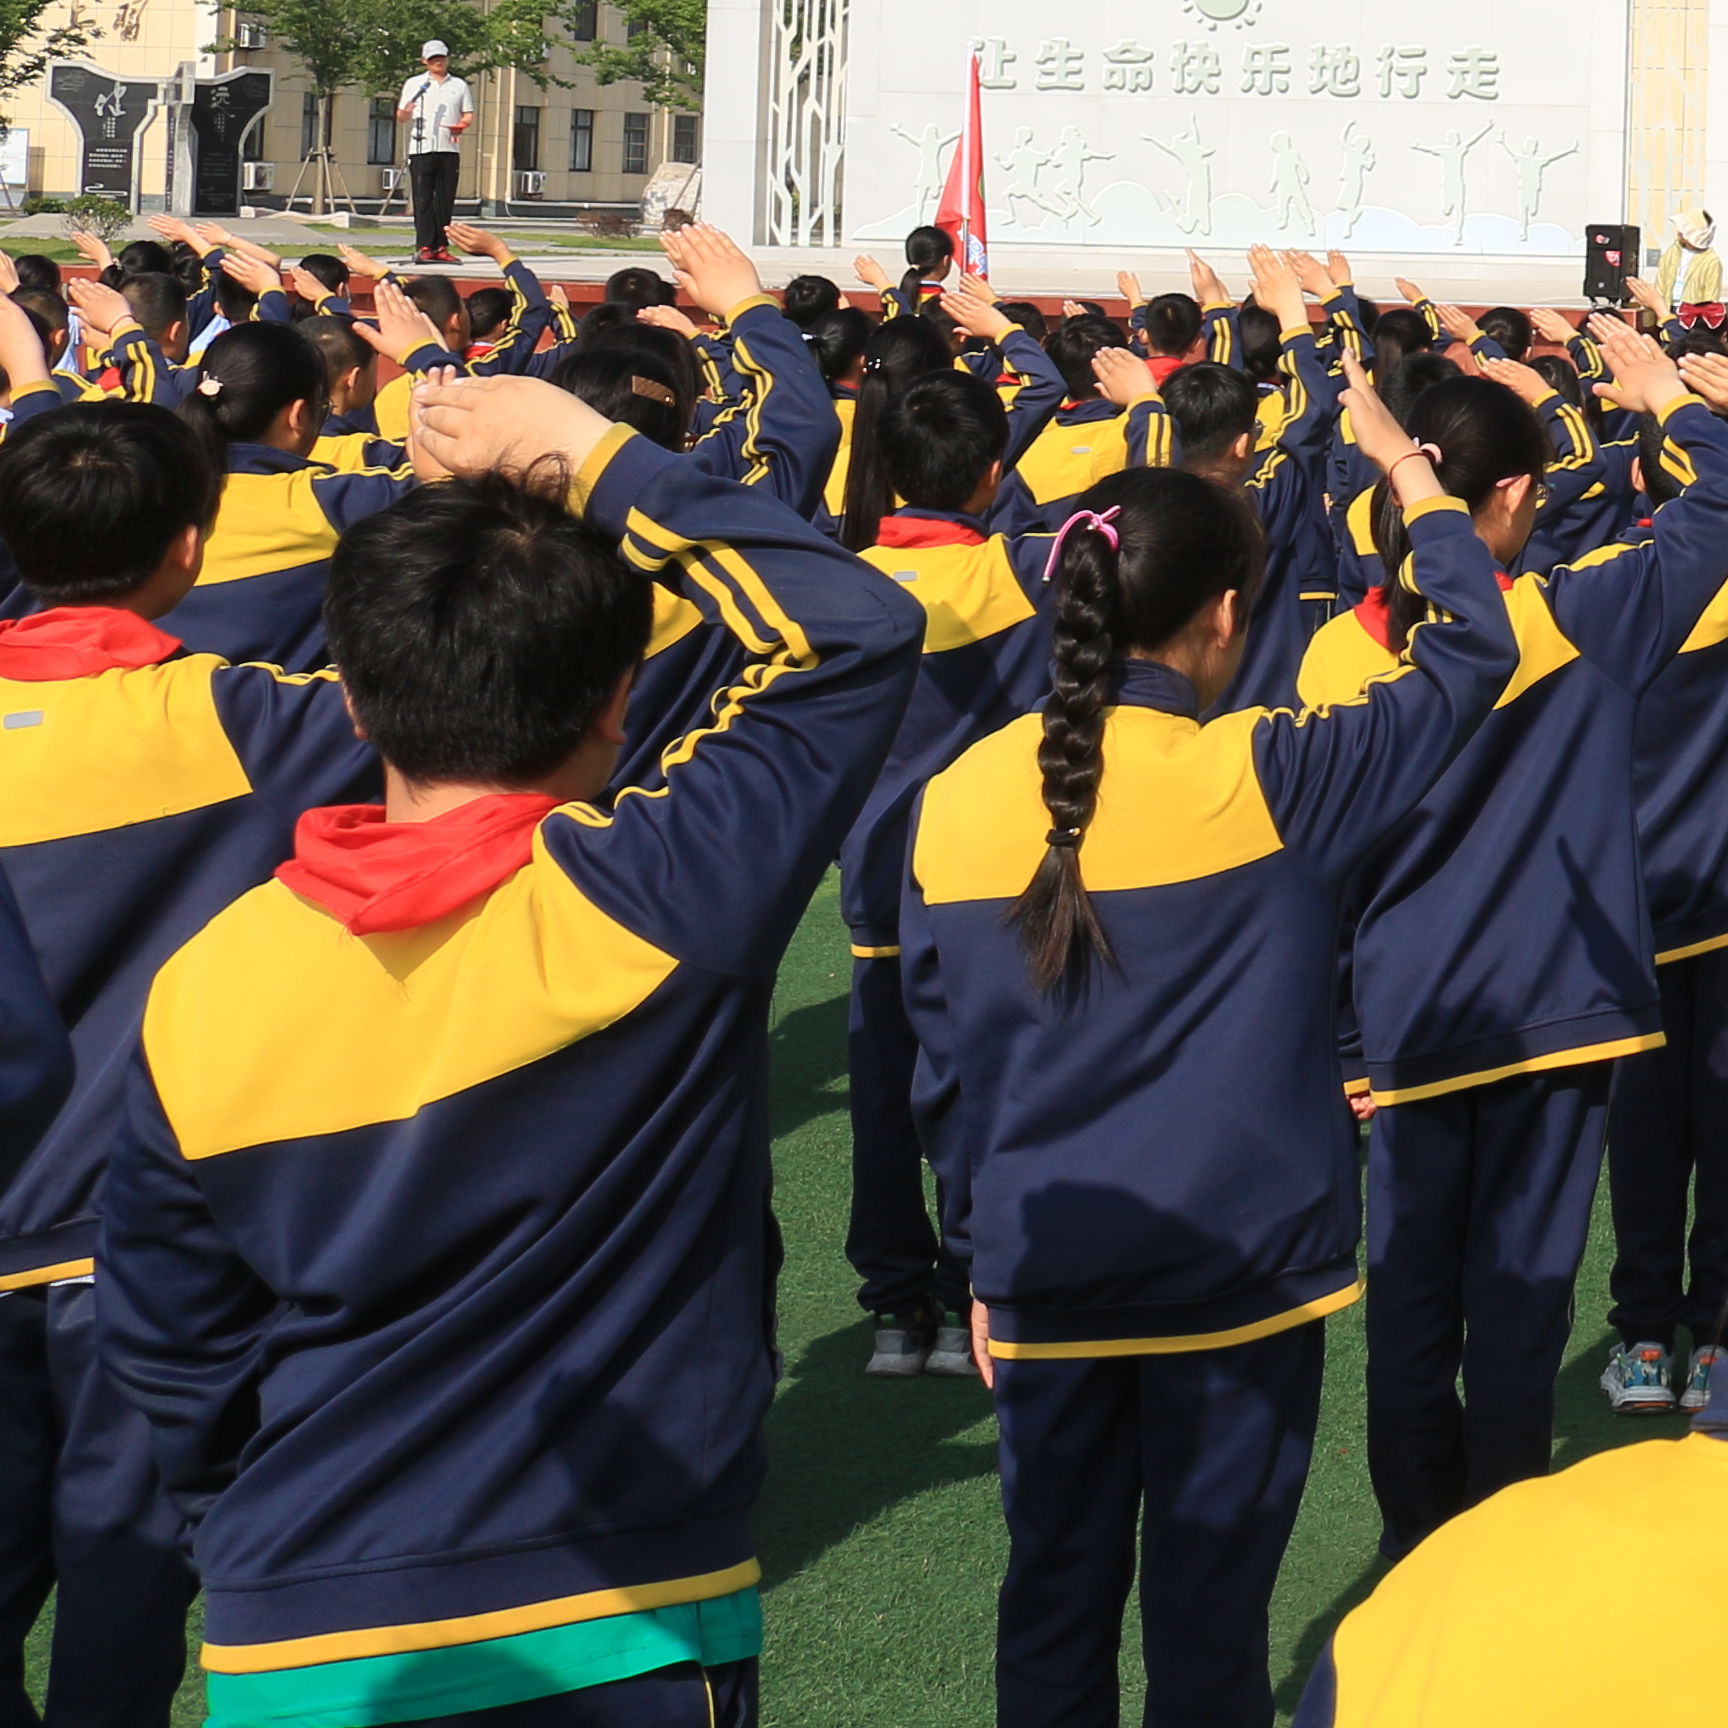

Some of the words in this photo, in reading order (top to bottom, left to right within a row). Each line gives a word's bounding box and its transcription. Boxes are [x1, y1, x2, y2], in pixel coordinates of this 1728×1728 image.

[972, 35, 1501, 100] 让生命快乐地行走
